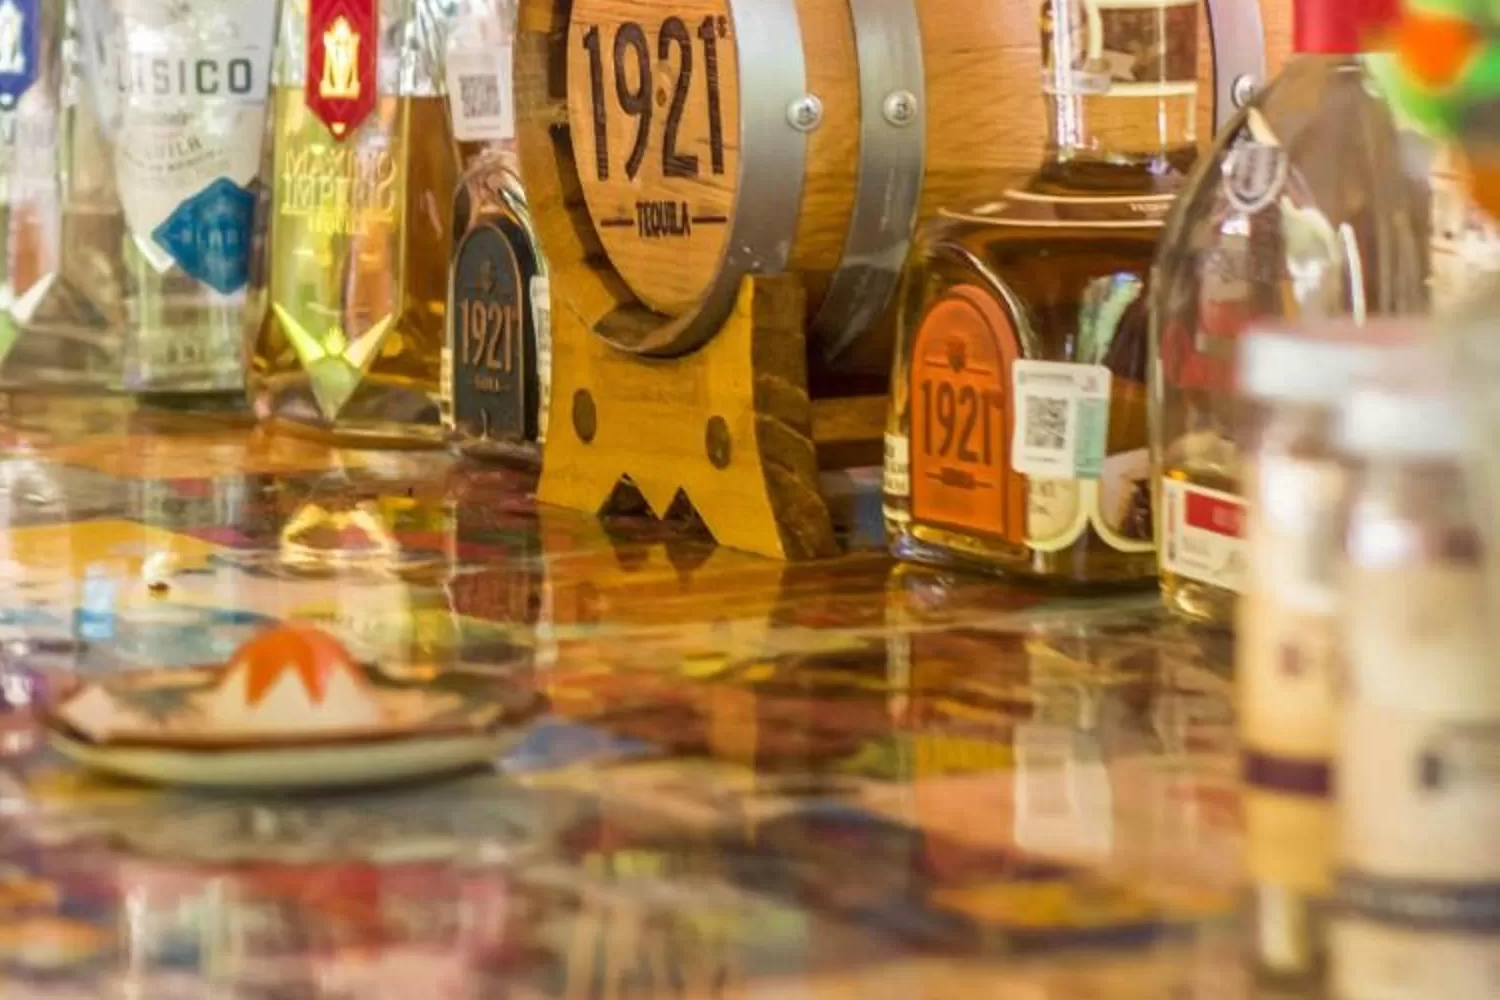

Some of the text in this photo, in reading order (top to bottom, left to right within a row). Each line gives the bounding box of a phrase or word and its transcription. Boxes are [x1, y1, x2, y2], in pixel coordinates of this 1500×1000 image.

[583, 16, 726, 182] 1921
[636, 202, 691, 238] TEQUILA
[460, 298, 513, 375] 1921
[921, 379, 1003, 468] 1921
